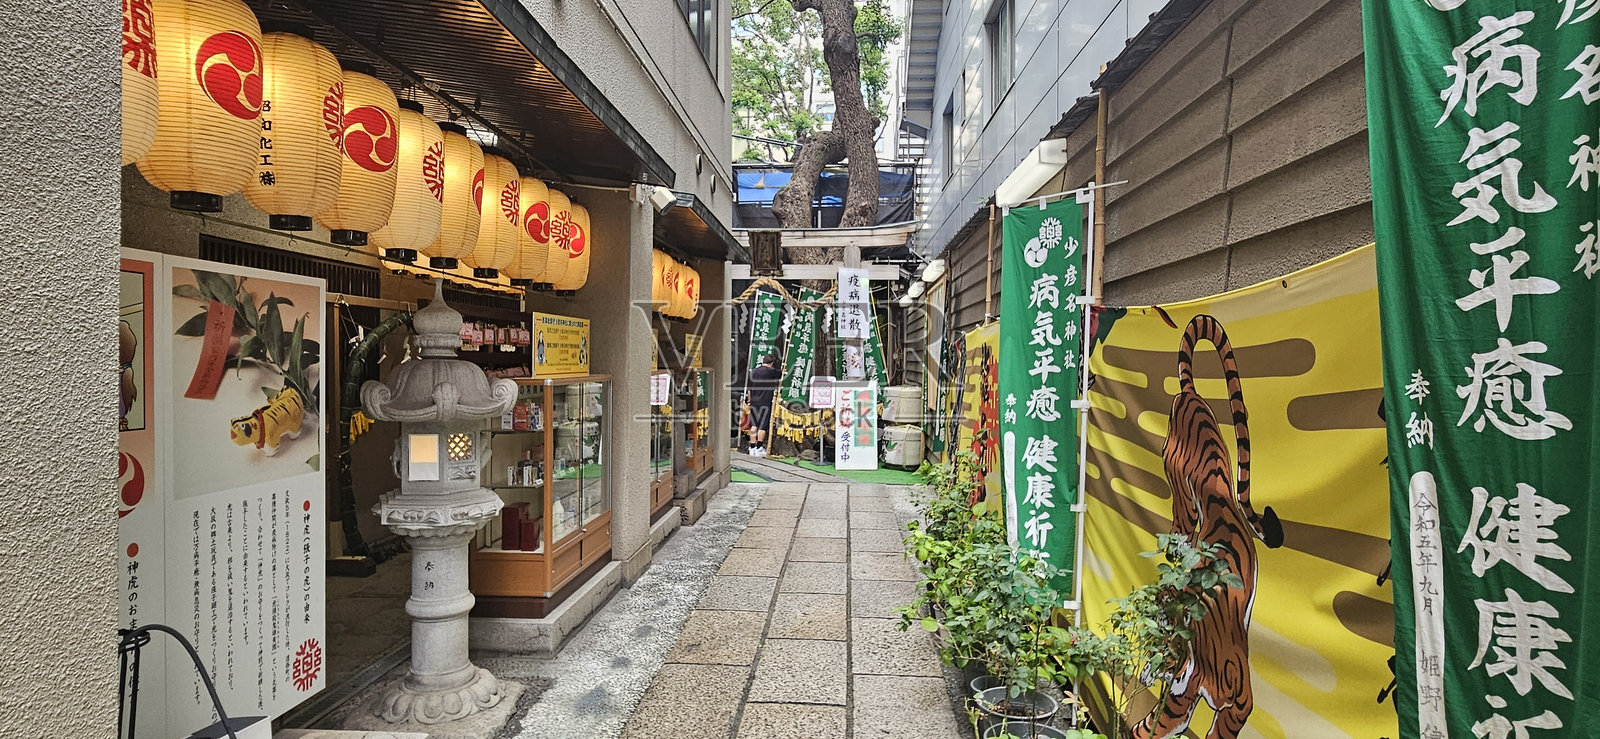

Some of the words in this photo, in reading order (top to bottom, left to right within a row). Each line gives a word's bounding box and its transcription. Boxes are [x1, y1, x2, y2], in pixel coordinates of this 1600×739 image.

[1435, 10, 1574, 440] 病気平癒
[847, 274, 862, 331] 疫病退散
[1025, 273, 1063, 422] 病気平癒
[1063, 236, 1079, 370] 少彦名神社
[1004, 393, 1017, 425] 奉納
[1405, 368, 1434, 450] 奉納
[1413, 492, 1439, 616] 令和五年九月
